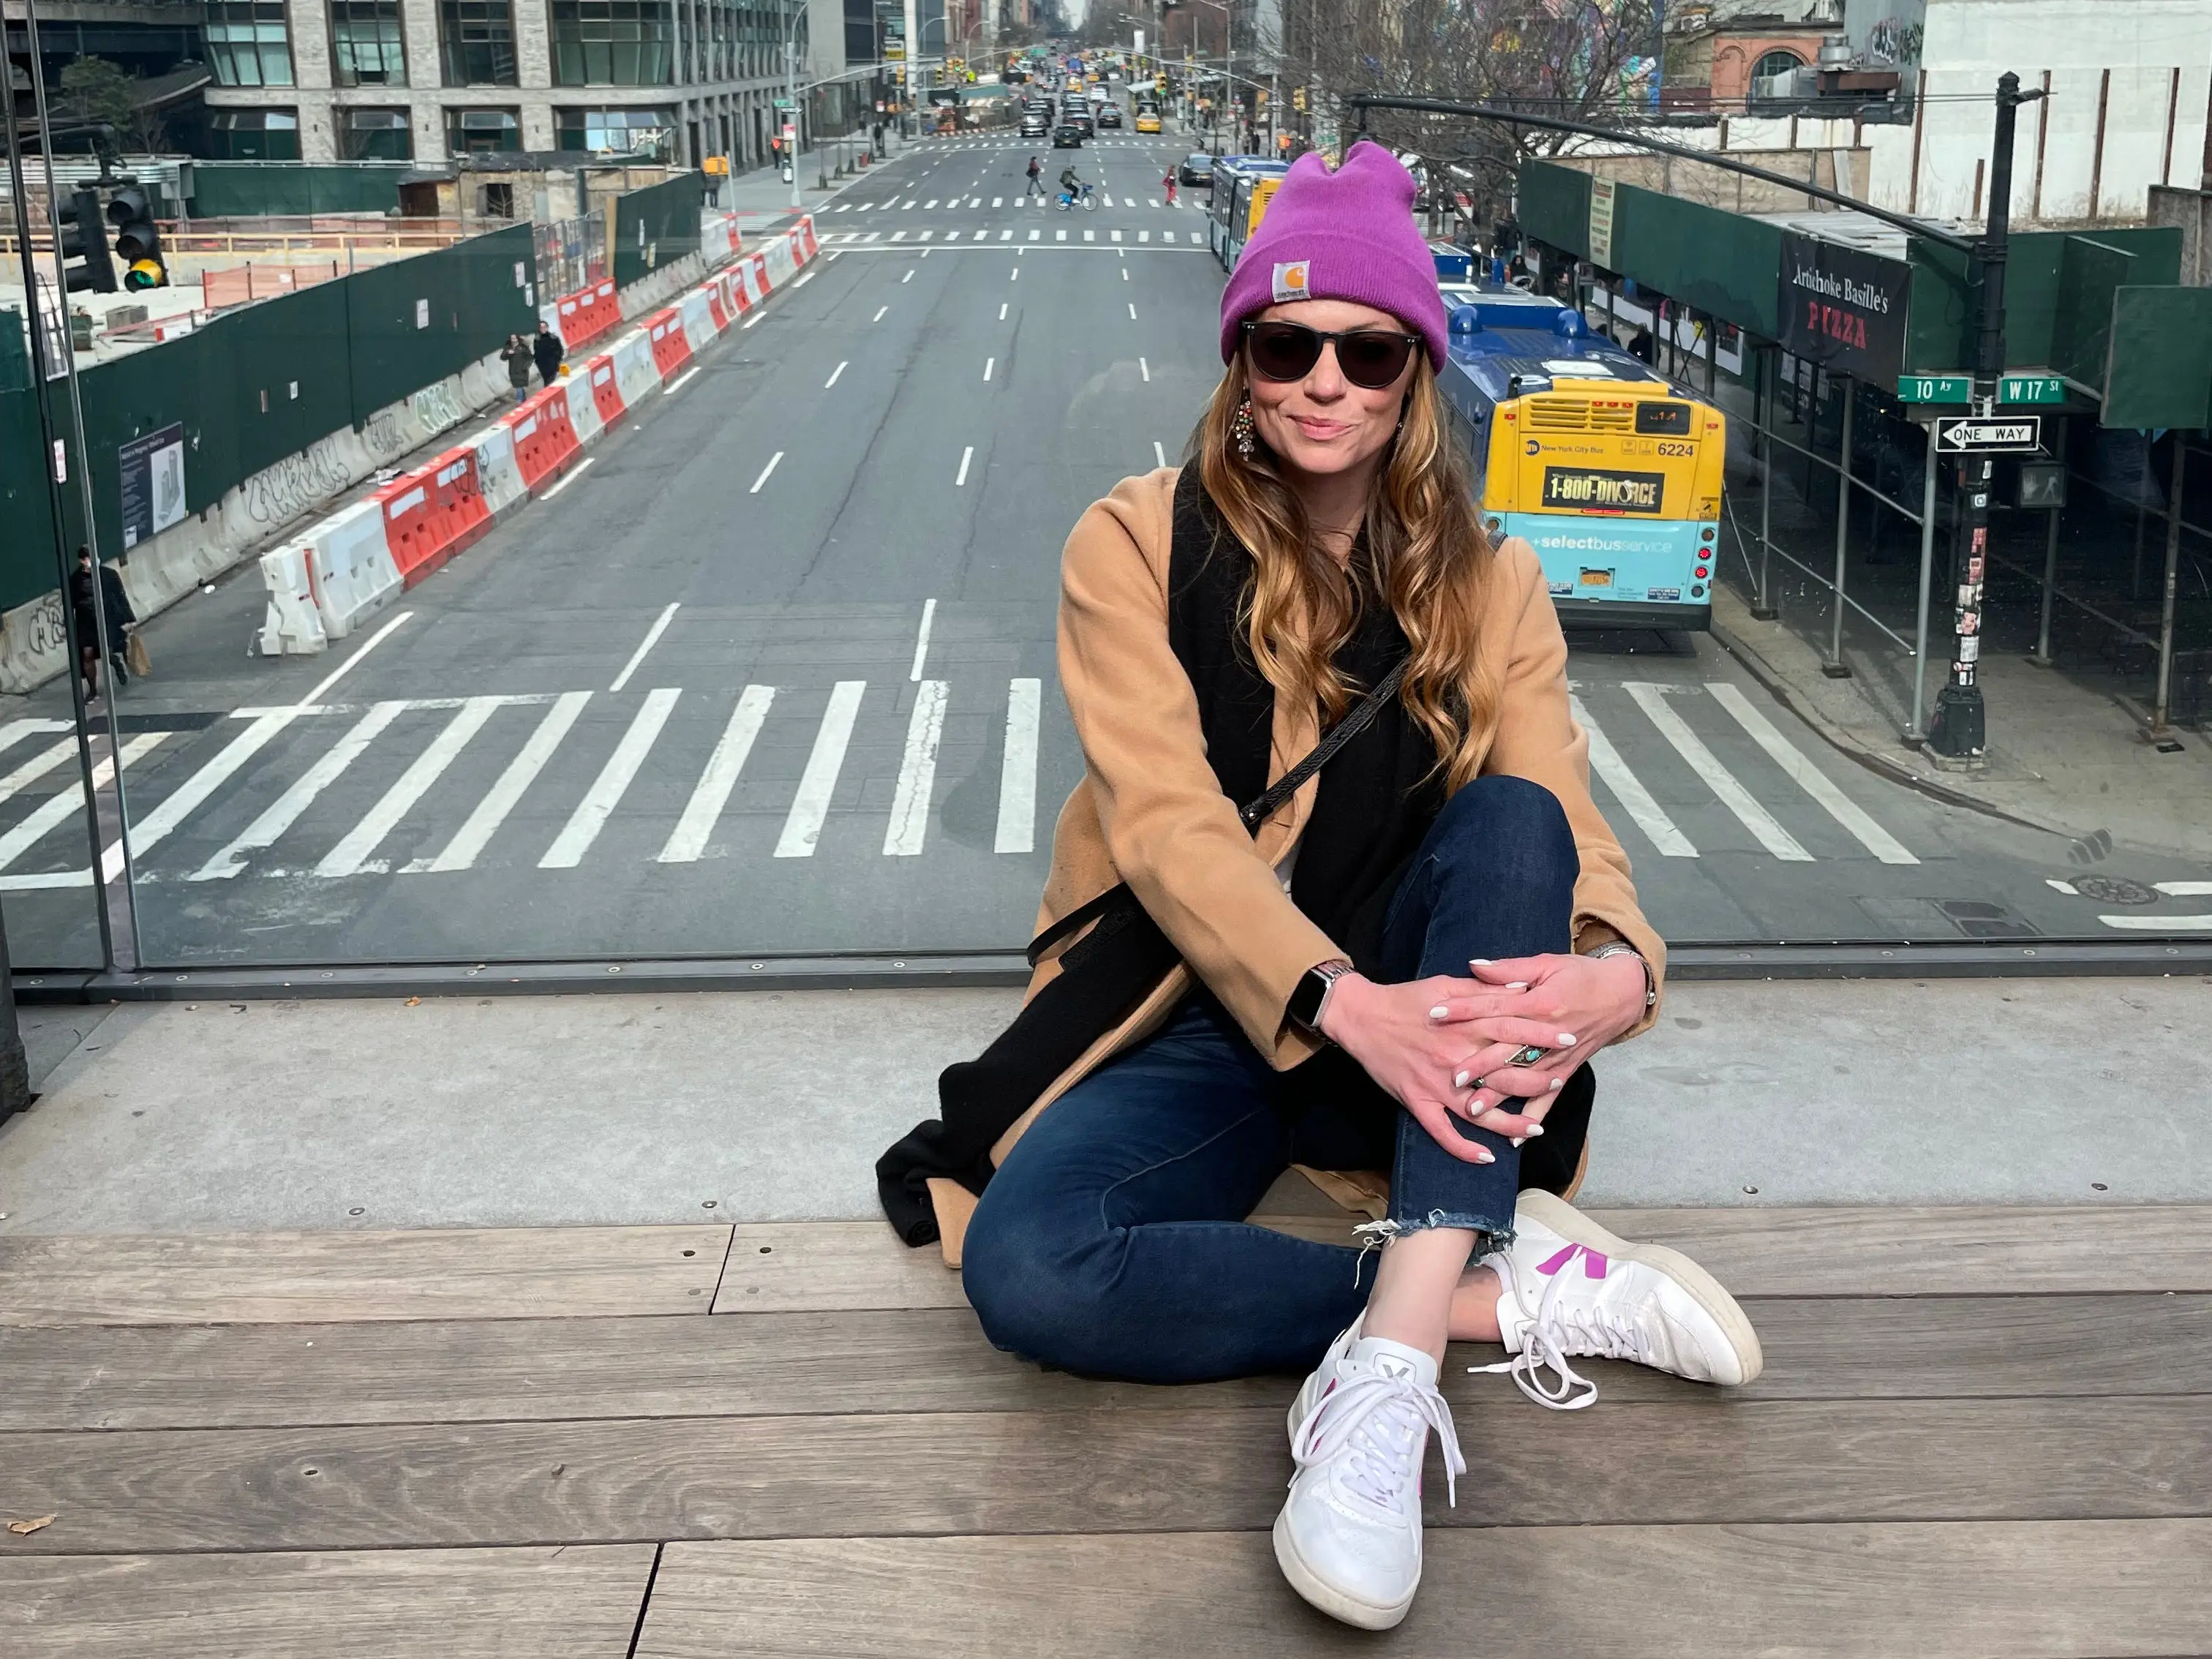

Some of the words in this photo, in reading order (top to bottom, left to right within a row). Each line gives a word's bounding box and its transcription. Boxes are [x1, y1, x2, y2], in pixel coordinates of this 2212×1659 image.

[1791, 263, 1842, 298] Artichoke
[1844, 278, 1889, 314] Basille's
[1807, 301, 1867, 350] PIZZA
[1916, 380, 1933, 399] 10
[2009, 381, 2023, 400] W
[2028, 381, 2043, 400] 17
[1954, 428, 1982, 441] ONE
[1995, 428, 2025, 440] WAY
[1575, 445, 1589, 454] City
[1658, 443, 1693, 457] 6224
